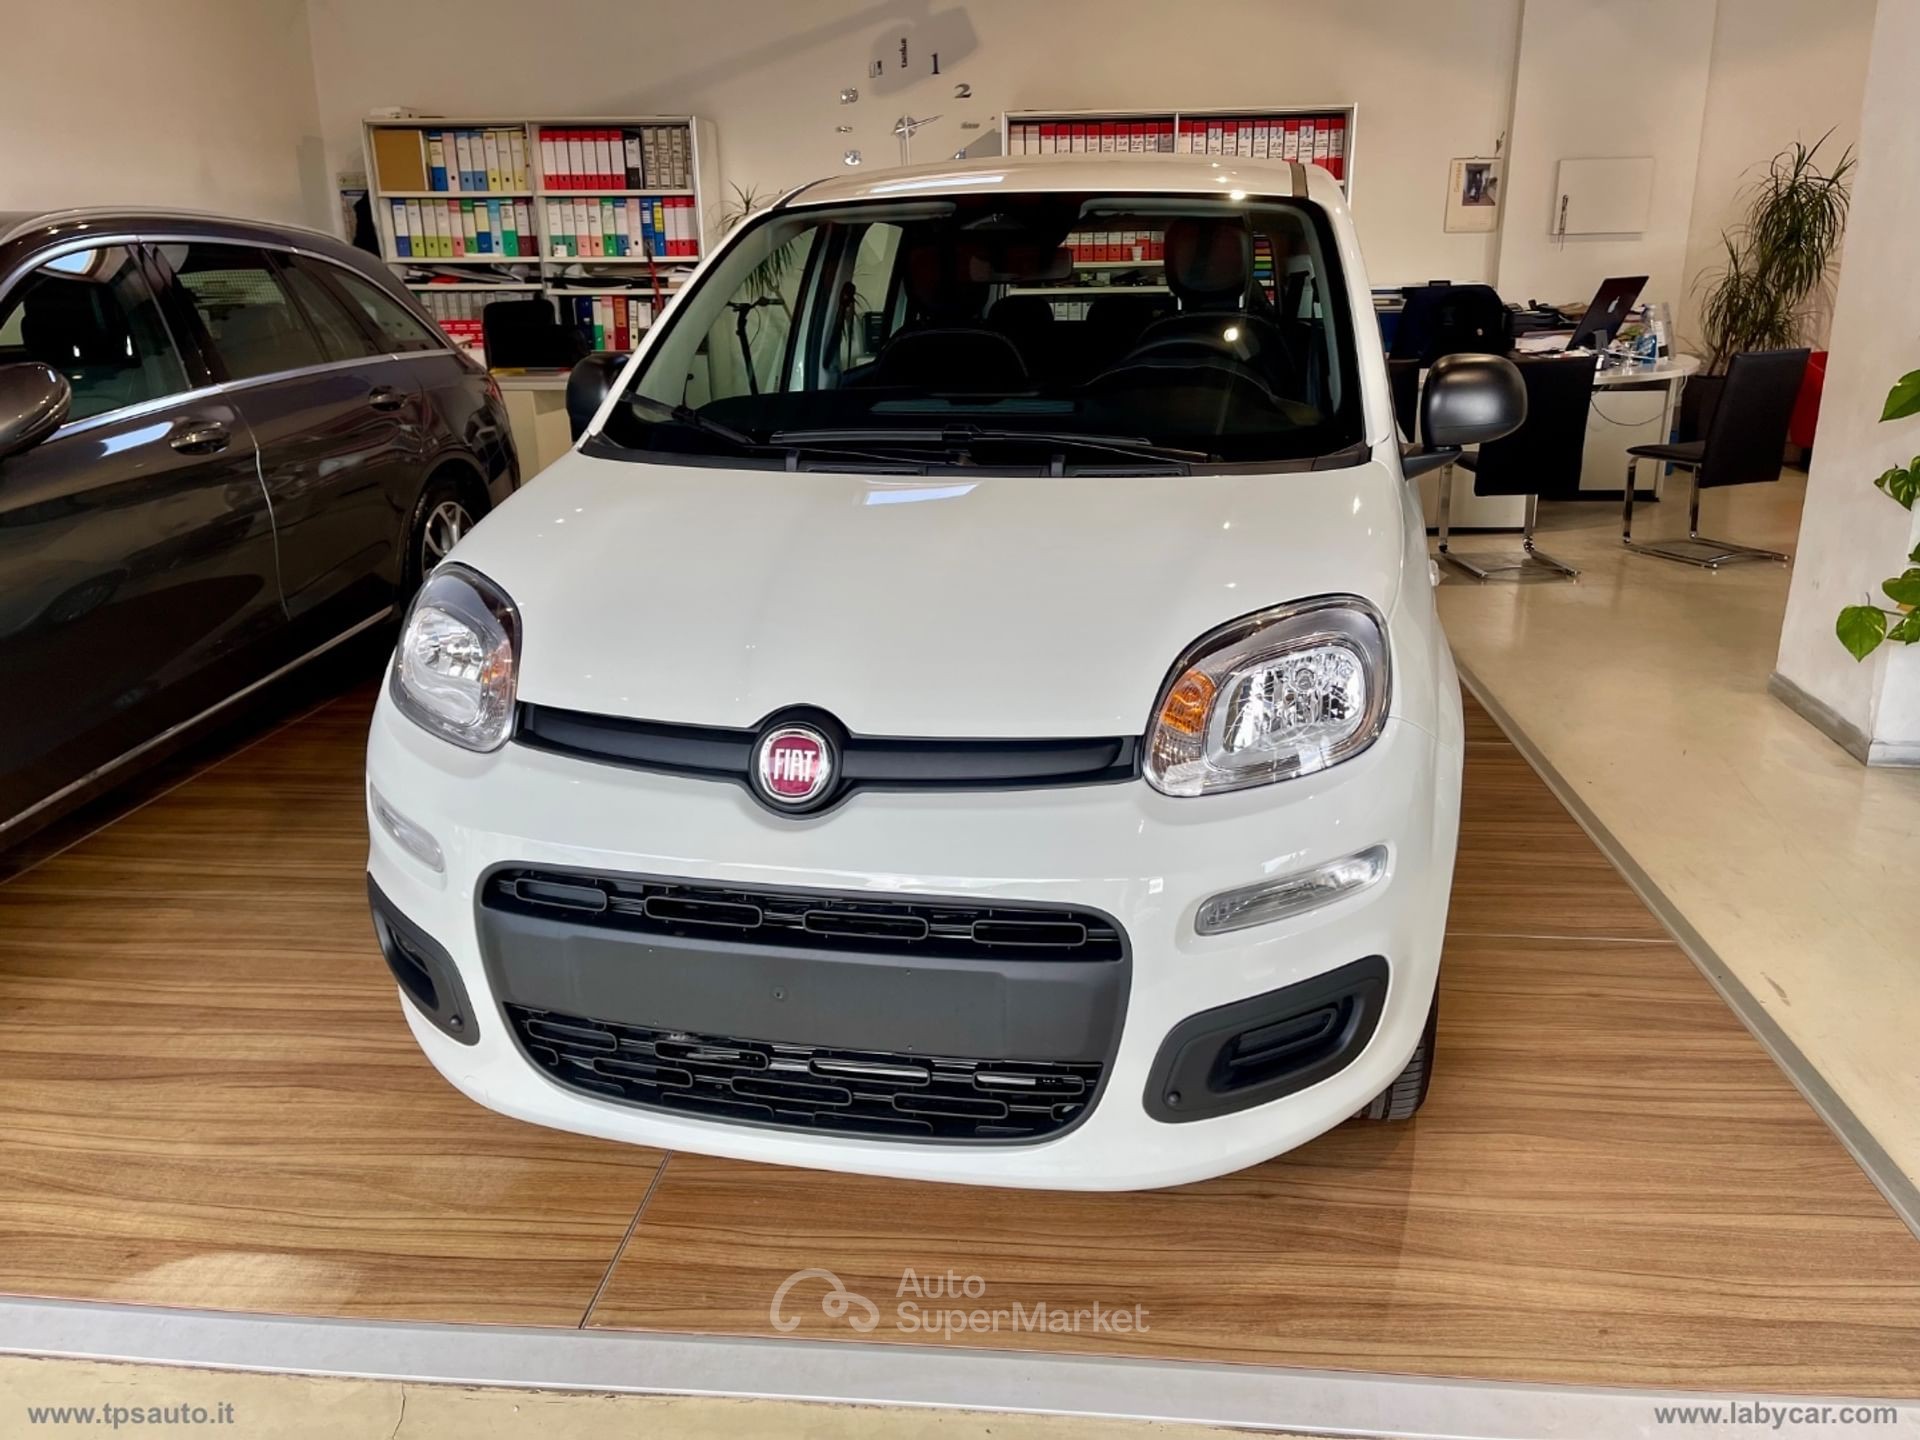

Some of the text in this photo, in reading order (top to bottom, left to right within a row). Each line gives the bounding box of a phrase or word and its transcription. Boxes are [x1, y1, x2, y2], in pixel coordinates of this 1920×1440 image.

[931, 53, 940, 75] 1
[954, 83, 972, 99] 2
[773, 748, 817, 782] FIAT
